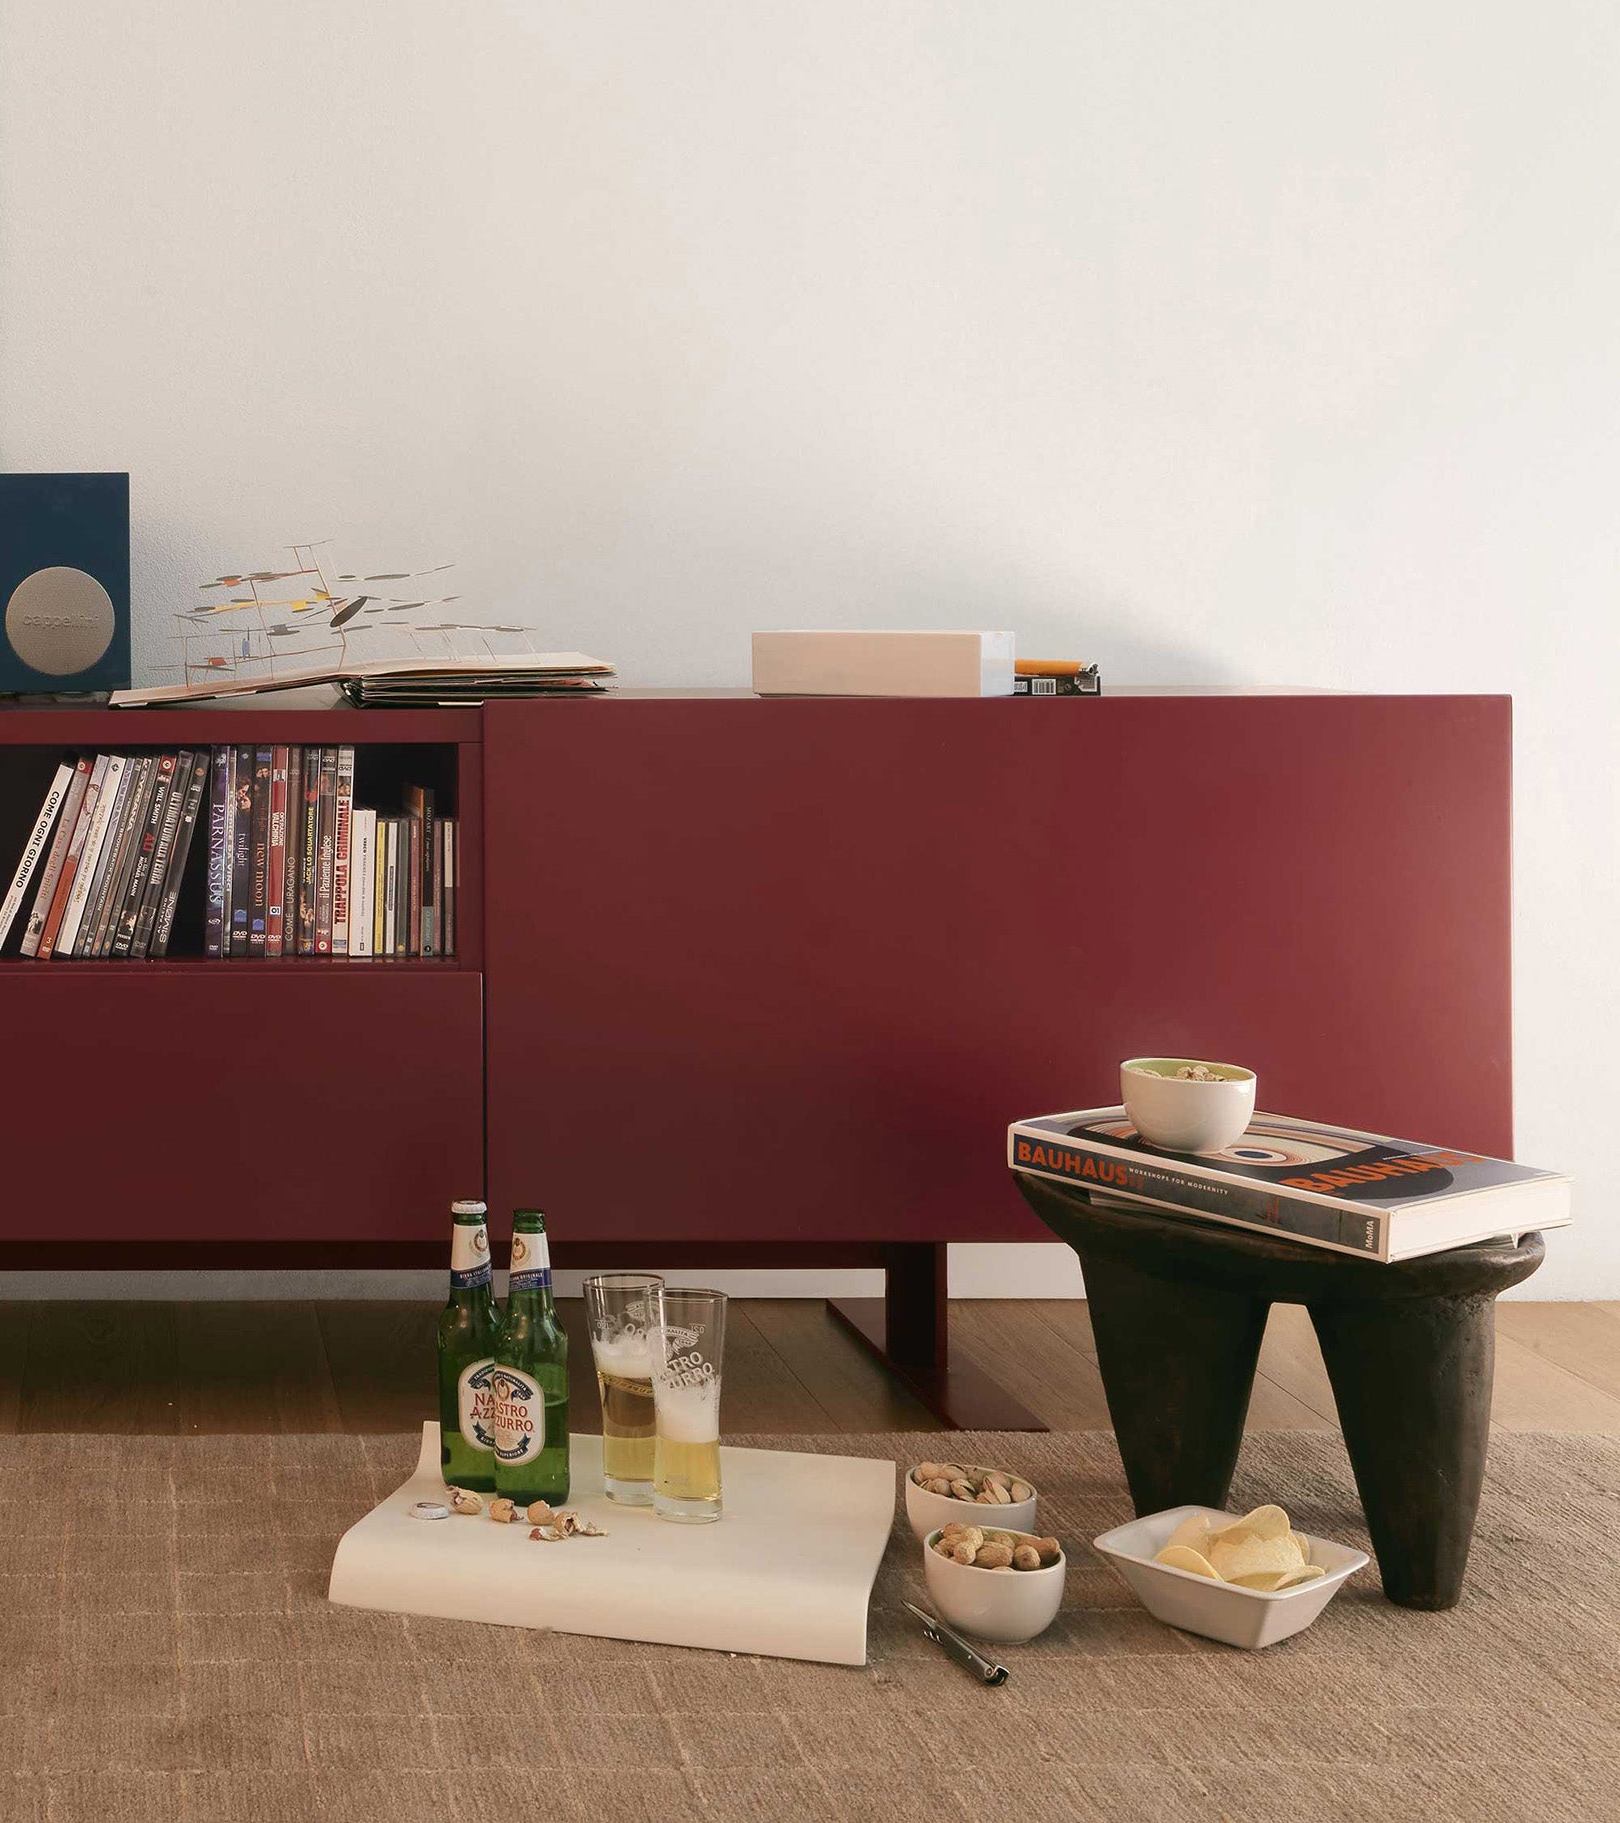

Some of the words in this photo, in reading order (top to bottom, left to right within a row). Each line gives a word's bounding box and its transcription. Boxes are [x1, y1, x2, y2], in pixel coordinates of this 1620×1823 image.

[42, 790, 60, 818] COME
[155, 785, 164, 802] WILL
[60, 817, 69, 829] La
[149, 802, 160, 824] SMITH
[160, 791, 182, 842] ULTIMATUM
[31, 819, 48, 847] OGNI
[54, 829, 65, 850] Casa
[141, 832, 155, 852] ALI
[271, 812, 279, 846] VALCHIRIA
[306, 805, 314, 855] SQUARTATORE
[335, 799, 349, 860] CRIMINALE
[156, 841, 169, 858] ALLA
[208, 803, 225, 902] PARNASSUS
[235, 832, 249, 866] twilight
[255, 842, 266, 869] new
[306, 857, 312, 866] LO
[320, 835, 332, 860] Inglese
[14, 847, 36, 888] GIORNO
[134, 855, 144, 878] MICHAEL
[149, 858, 165, 885] TERRA
[285, 856, 296, 903] URAGANO
[319, 862, 330, 891] Paziente
[38, 872, 54, 899] Spiriti
[129, 878, 138, 896] MANN
[254, 871, 265, 906] moon
[334, 863, 347, 924] TRAPPOLA
[284, 912, 294, 941] COME
[1017, 1141, 1129, 1185] BAUHAUS
[1279, 1151, 1485, 1193] BAUHAUS
[1129, 1167, 1170, 1183] WORKSHOPS
[1171, 1176, 1186, 1186] FOR
[1187, 1180, 1229, 1195] MODERNITY
[1365, 1220, 1374, 1249] MoMA
[495, 1402, 528, 1418] STRO
